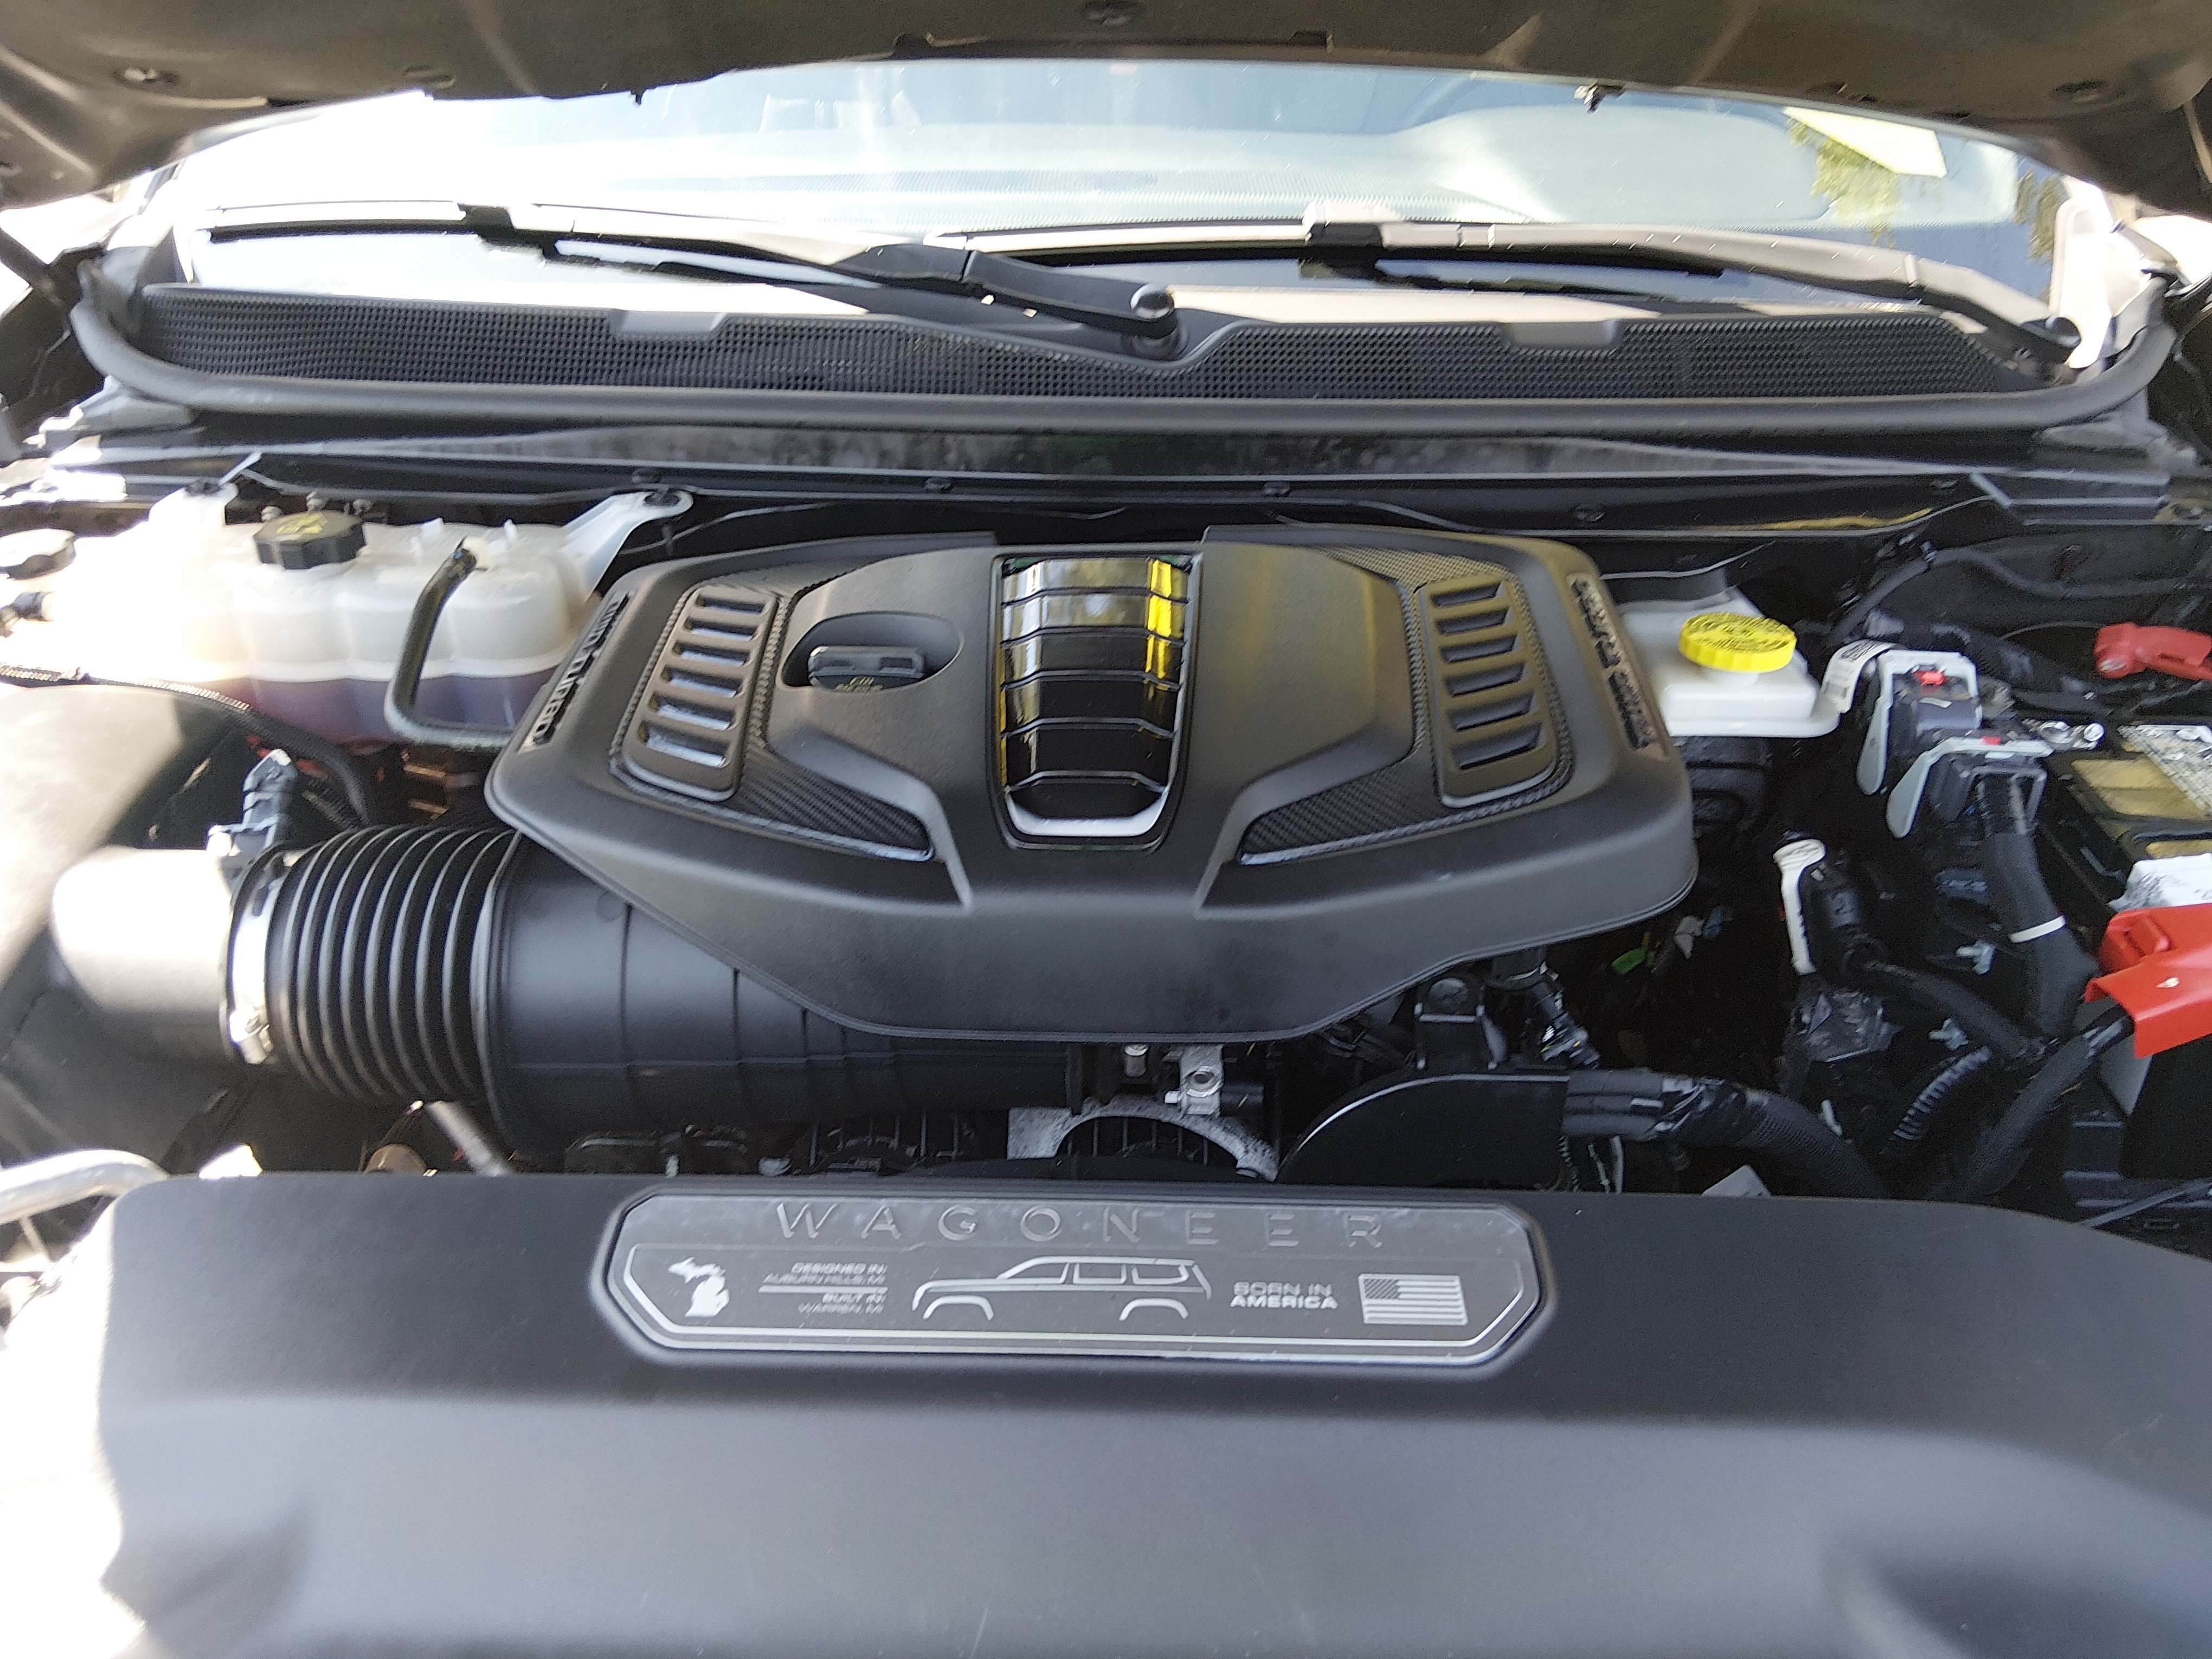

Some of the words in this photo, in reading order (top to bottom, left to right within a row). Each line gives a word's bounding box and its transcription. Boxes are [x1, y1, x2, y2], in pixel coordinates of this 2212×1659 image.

[776, 1201, 1384, 1248] WAGONEER
[1233, 1281, 1301, 1295] BORN
[1308, 1283, 1333, 1297] IN
[1230, 1295, 1339, 1309] AMERICA
